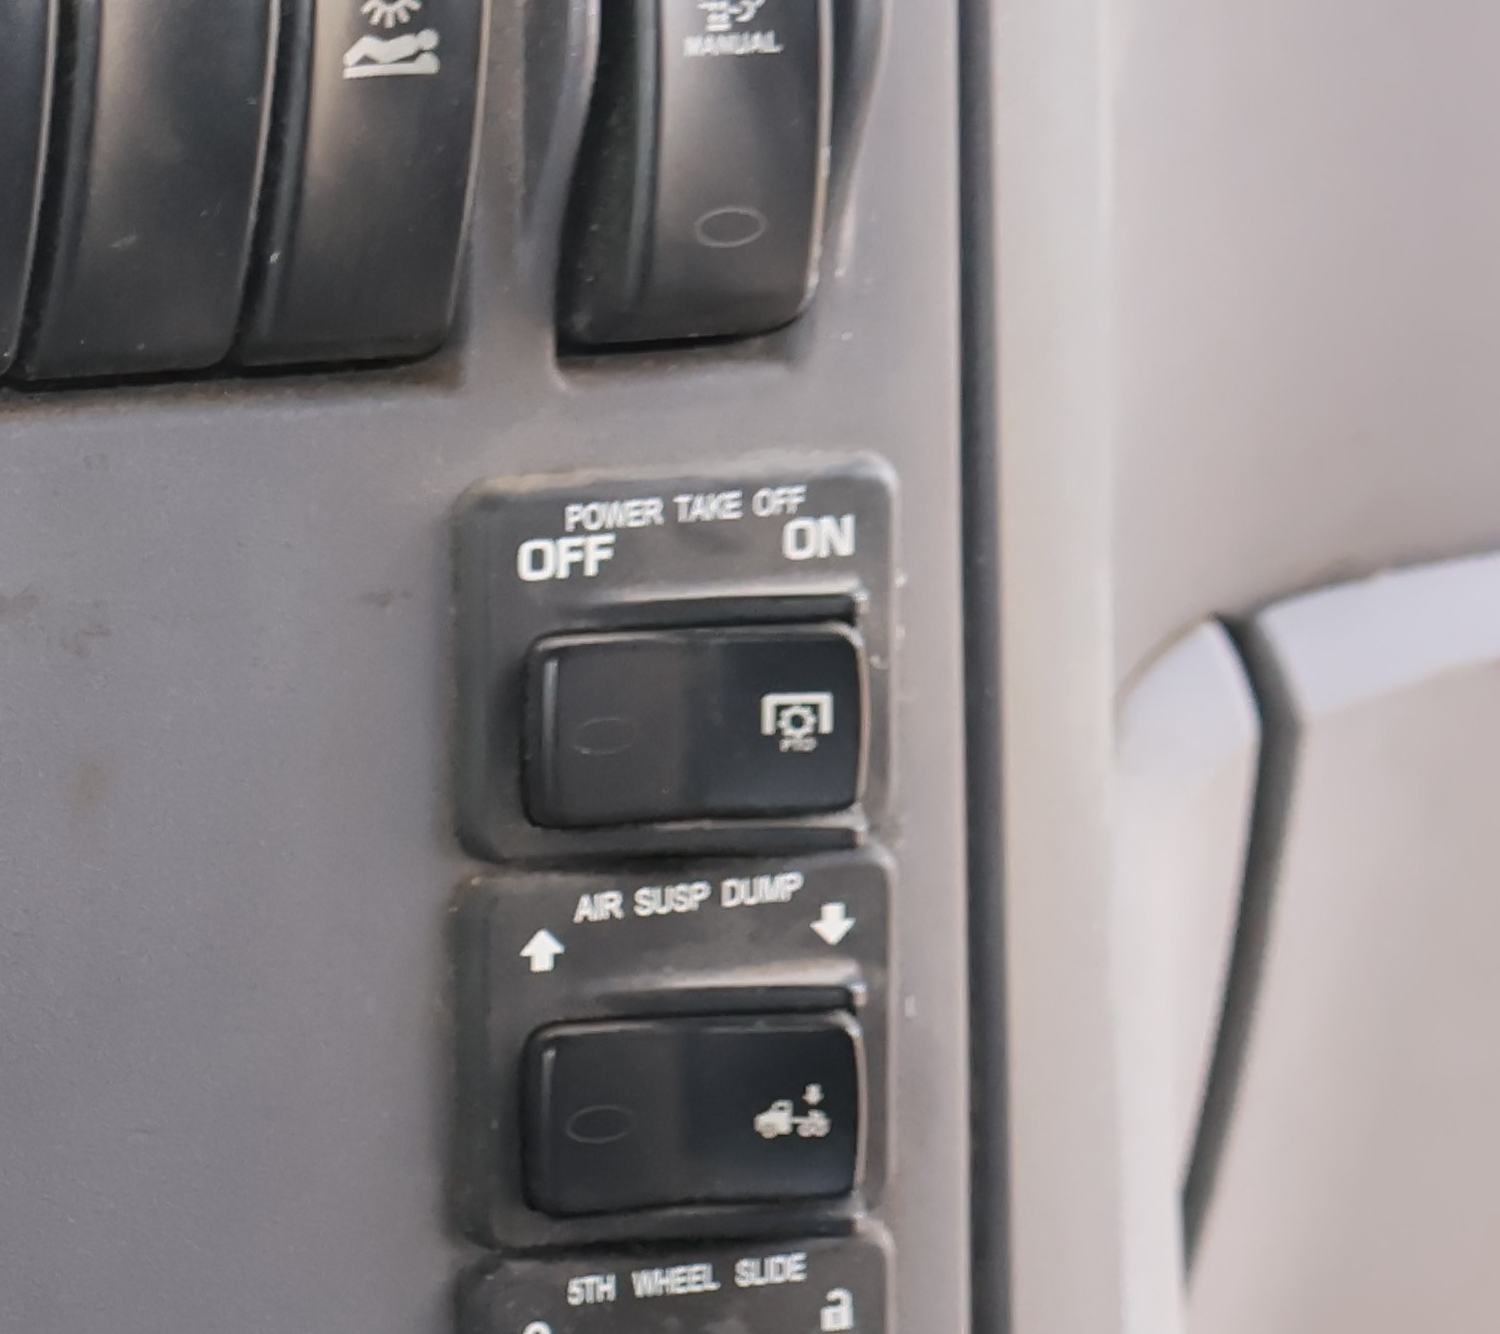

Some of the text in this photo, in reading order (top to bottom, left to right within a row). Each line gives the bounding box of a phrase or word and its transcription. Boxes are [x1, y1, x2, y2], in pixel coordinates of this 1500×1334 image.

[565, 485, 808, 532] POWER TAKE OFF
[517, 533, 616, 581] OFF
[782, 514, 856, 561] ON
[573, 872, 804, 923] AIR SUSP DUMP
[567, 1252, 807, 1306] 5TH WHEEL SLIDE
